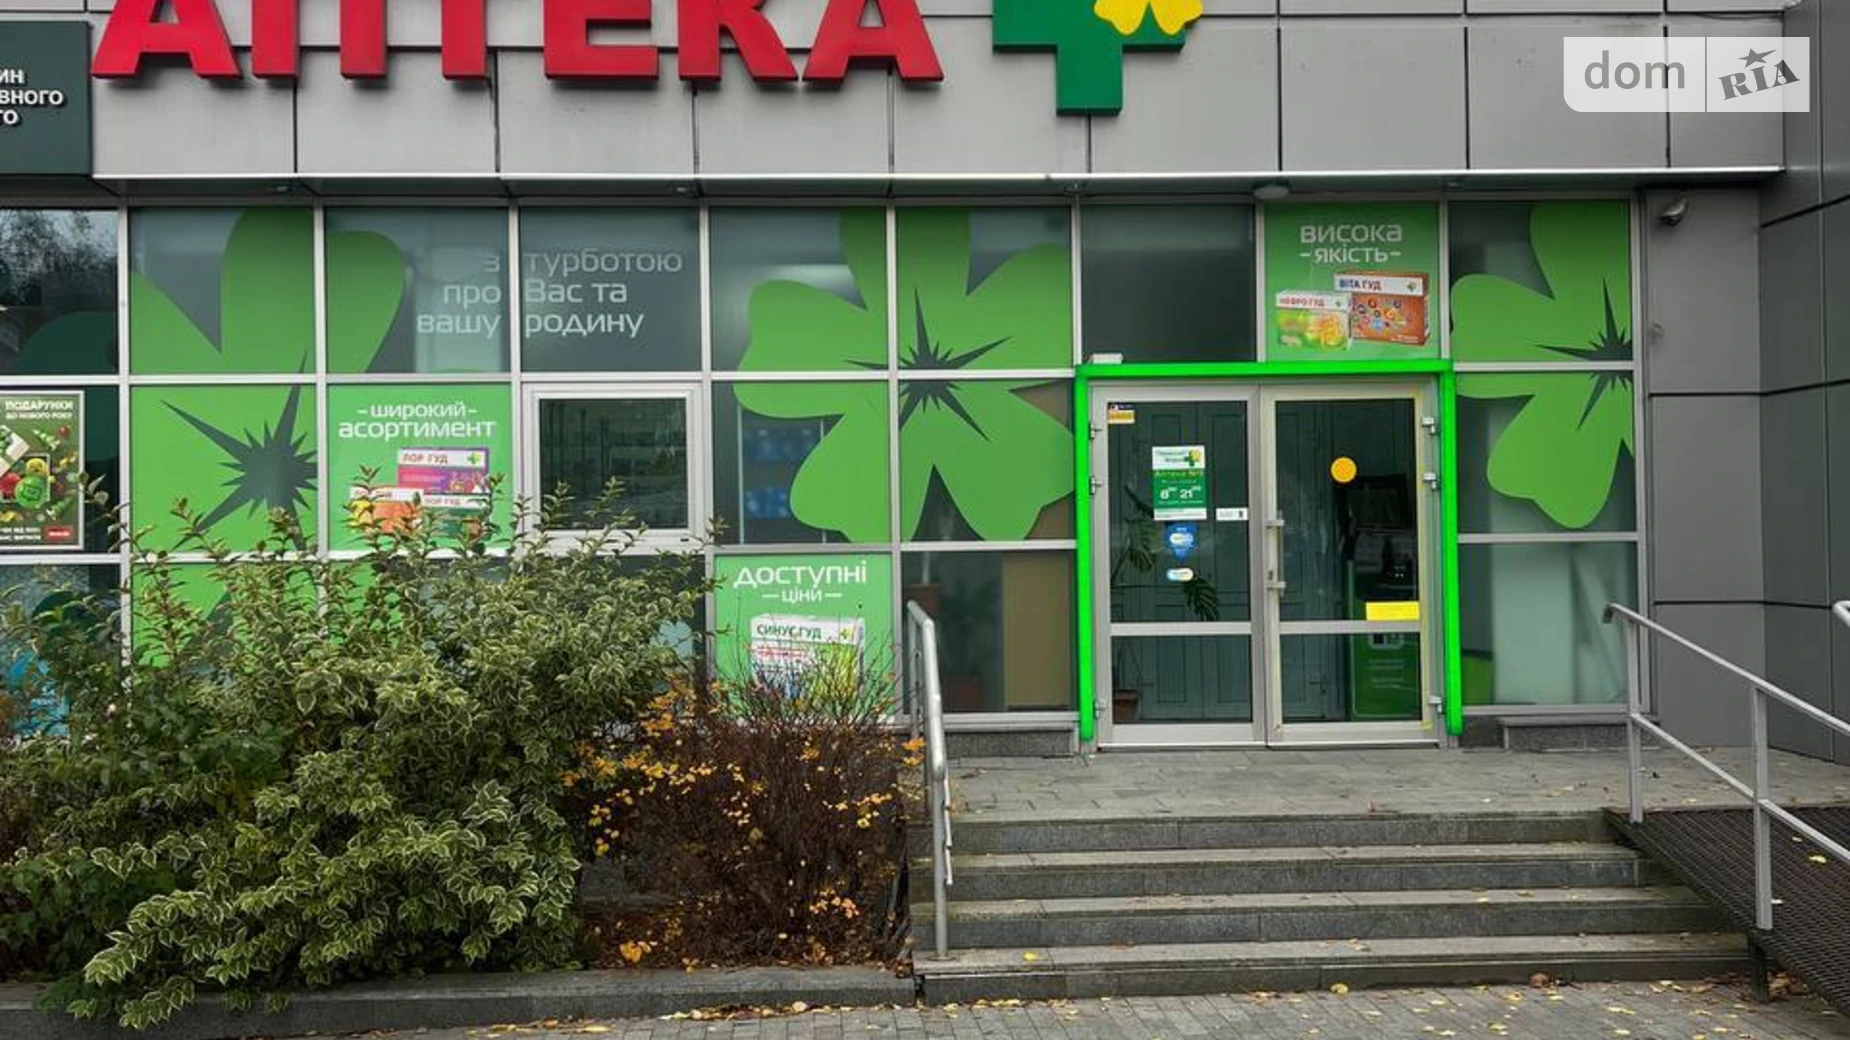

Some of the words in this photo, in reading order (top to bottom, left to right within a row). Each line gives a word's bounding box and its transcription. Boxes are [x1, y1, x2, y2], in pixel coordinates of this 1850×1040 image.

[91, 0, 943, 82] АПТЕКА
[526, 248, 682, 278] турботою
[443, 283, 502, 309] про
[524, 279, 582, 304] Вас
[592, 281, 627, 303] та
[417, 313, 501, 338] вашу
[524, 313, 644, 338] родину
[338, 420, 497, 441] асортимент
